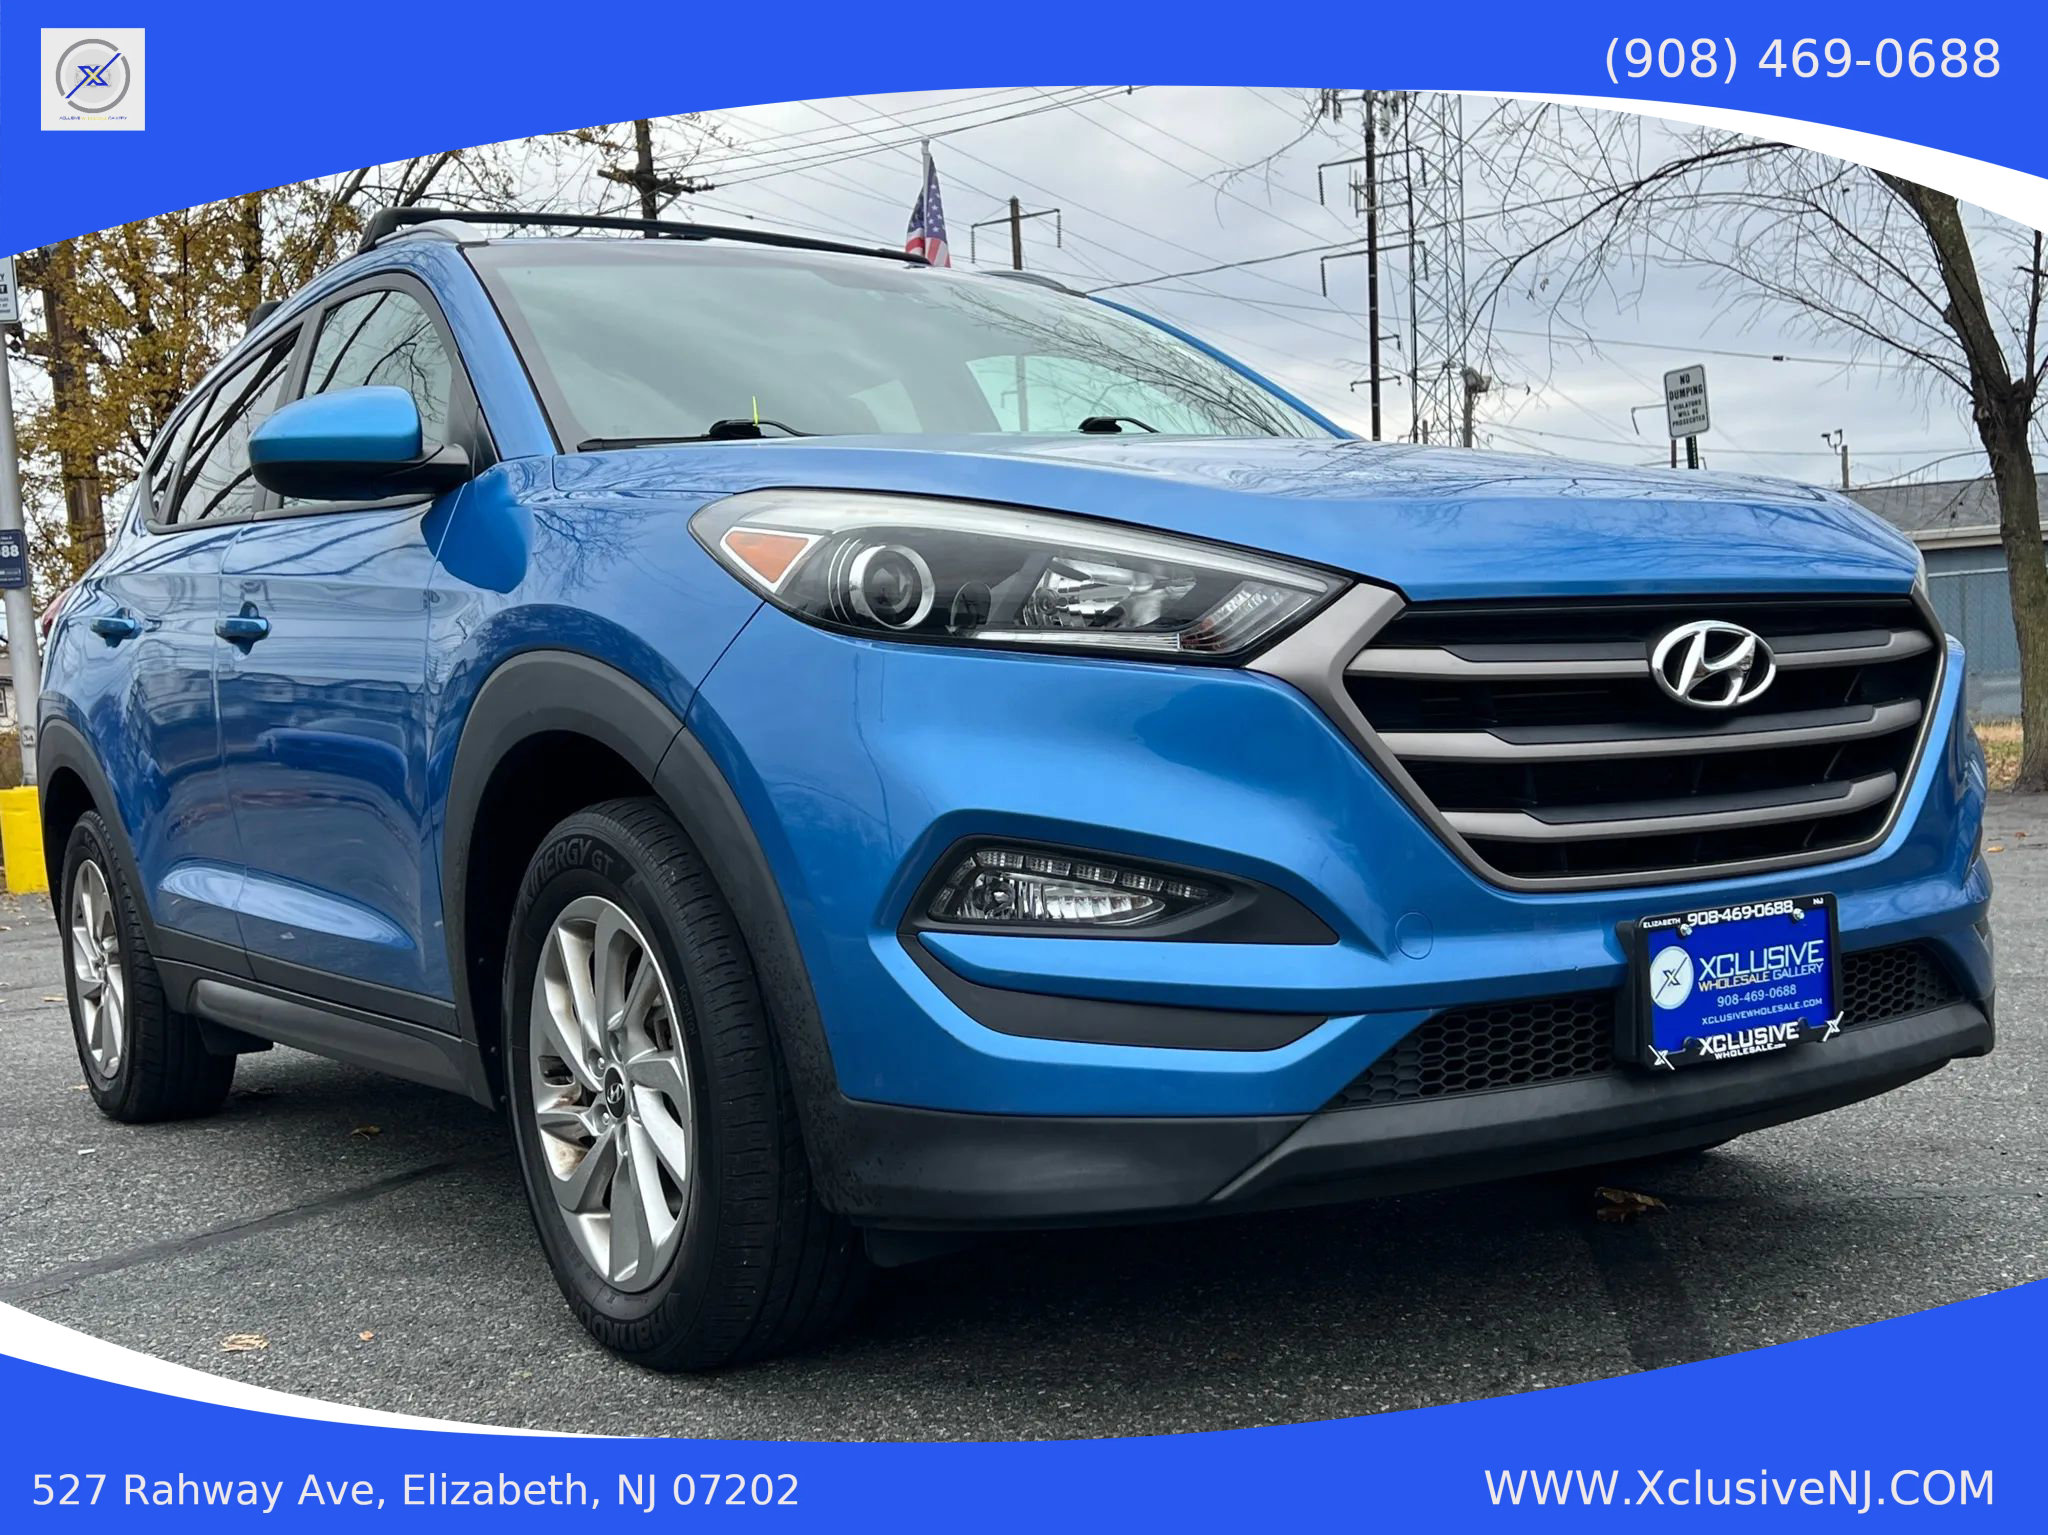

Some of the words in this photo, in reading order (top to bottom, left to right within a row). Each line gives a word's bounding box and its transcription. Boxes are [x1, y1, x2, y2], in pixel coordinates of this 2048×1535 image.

[1680, 373, 1690, 384] NO
[1669, 384, 1703, 401] DUMPING
[1672, 415, 1705, 427] PROSECUTED
[592, 849, 615, 877] GT
[1643, 918, 1681, 929] ELIZABETH
[1687, 900, 1794, 927] 908-469-0688
[1813, 897, 1824, 905] NJ
[1698, 939, 1824, 981] XCLUSIVE
[1698, 971, 1771, 992] WHOLESALE
[1773, 962, 1824, 981] GALLERY
[1717, 984, 1797, 1007] 908-469-0688
[1702, 998, 1823, 1025] XCLUSIVEWHOLESALE.COM
[1699, 1021, 1799, 1056] XCLUSIVE
